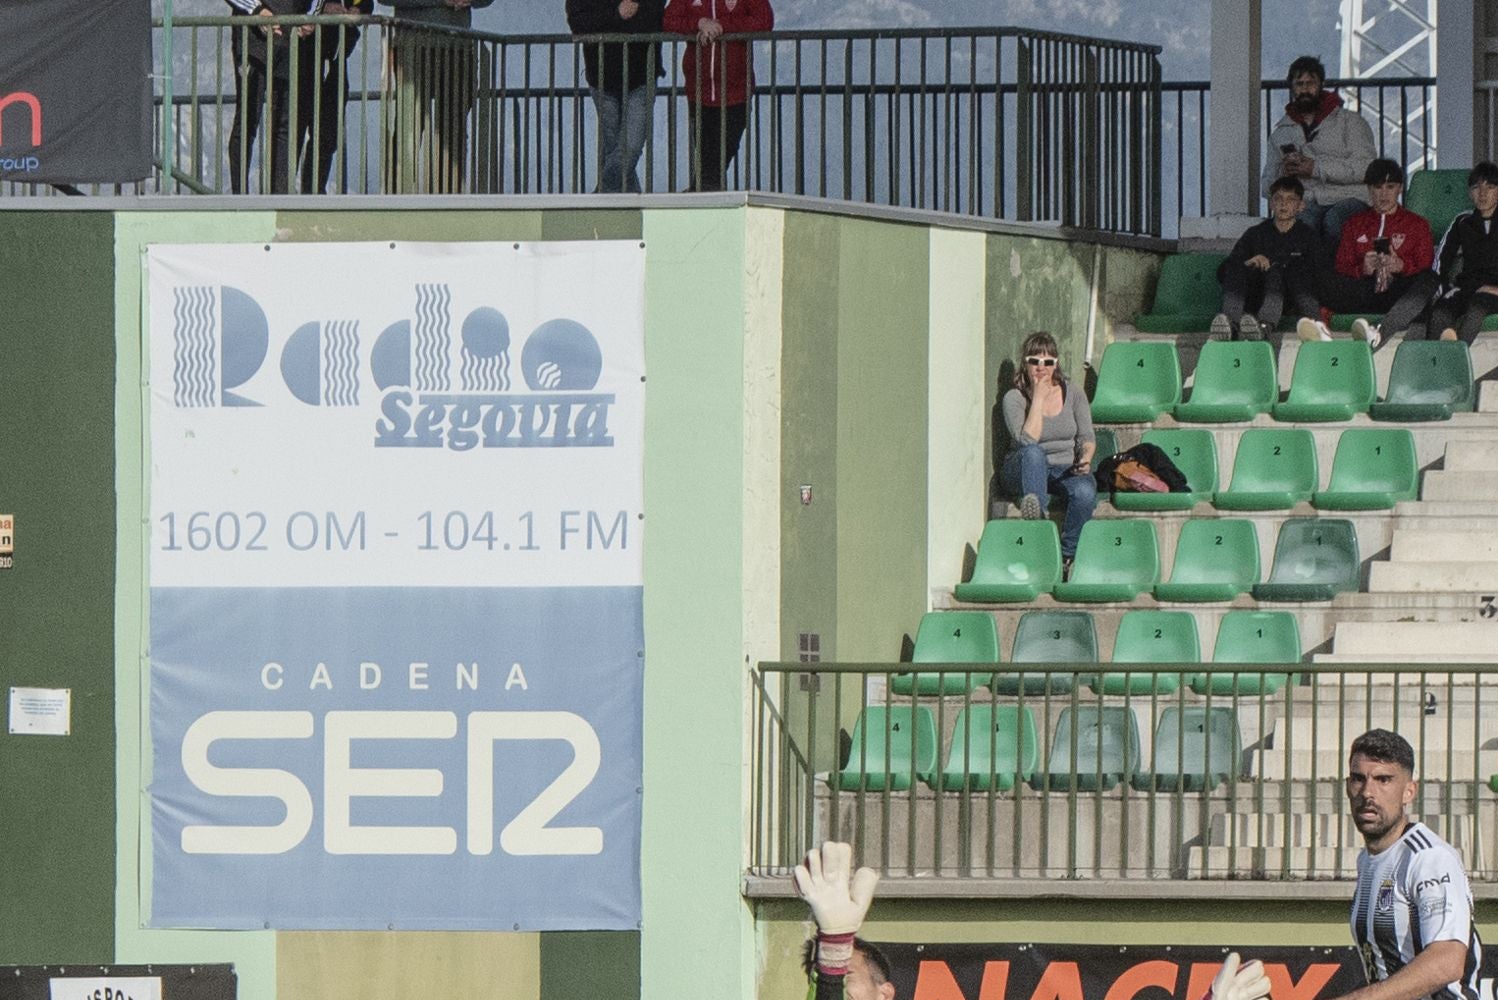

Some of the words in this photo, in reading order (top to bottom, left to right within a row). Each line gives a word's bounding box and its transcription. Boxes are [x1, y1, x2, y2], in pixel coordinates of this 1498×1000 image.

[173, 283, 602, 407] Radio
[374, 390, 615, 452] Segovia
[159, 510, 269, 552] 1602
[285, 509, 367, 551] OM
[416, 509, 540, 551] 104.1
[559, 509, 629, 551] FM
[1478, 596, 1498, 619] 3
[260, 662, 529, 690] CADENA
[181, 711, 603, 855] SER
